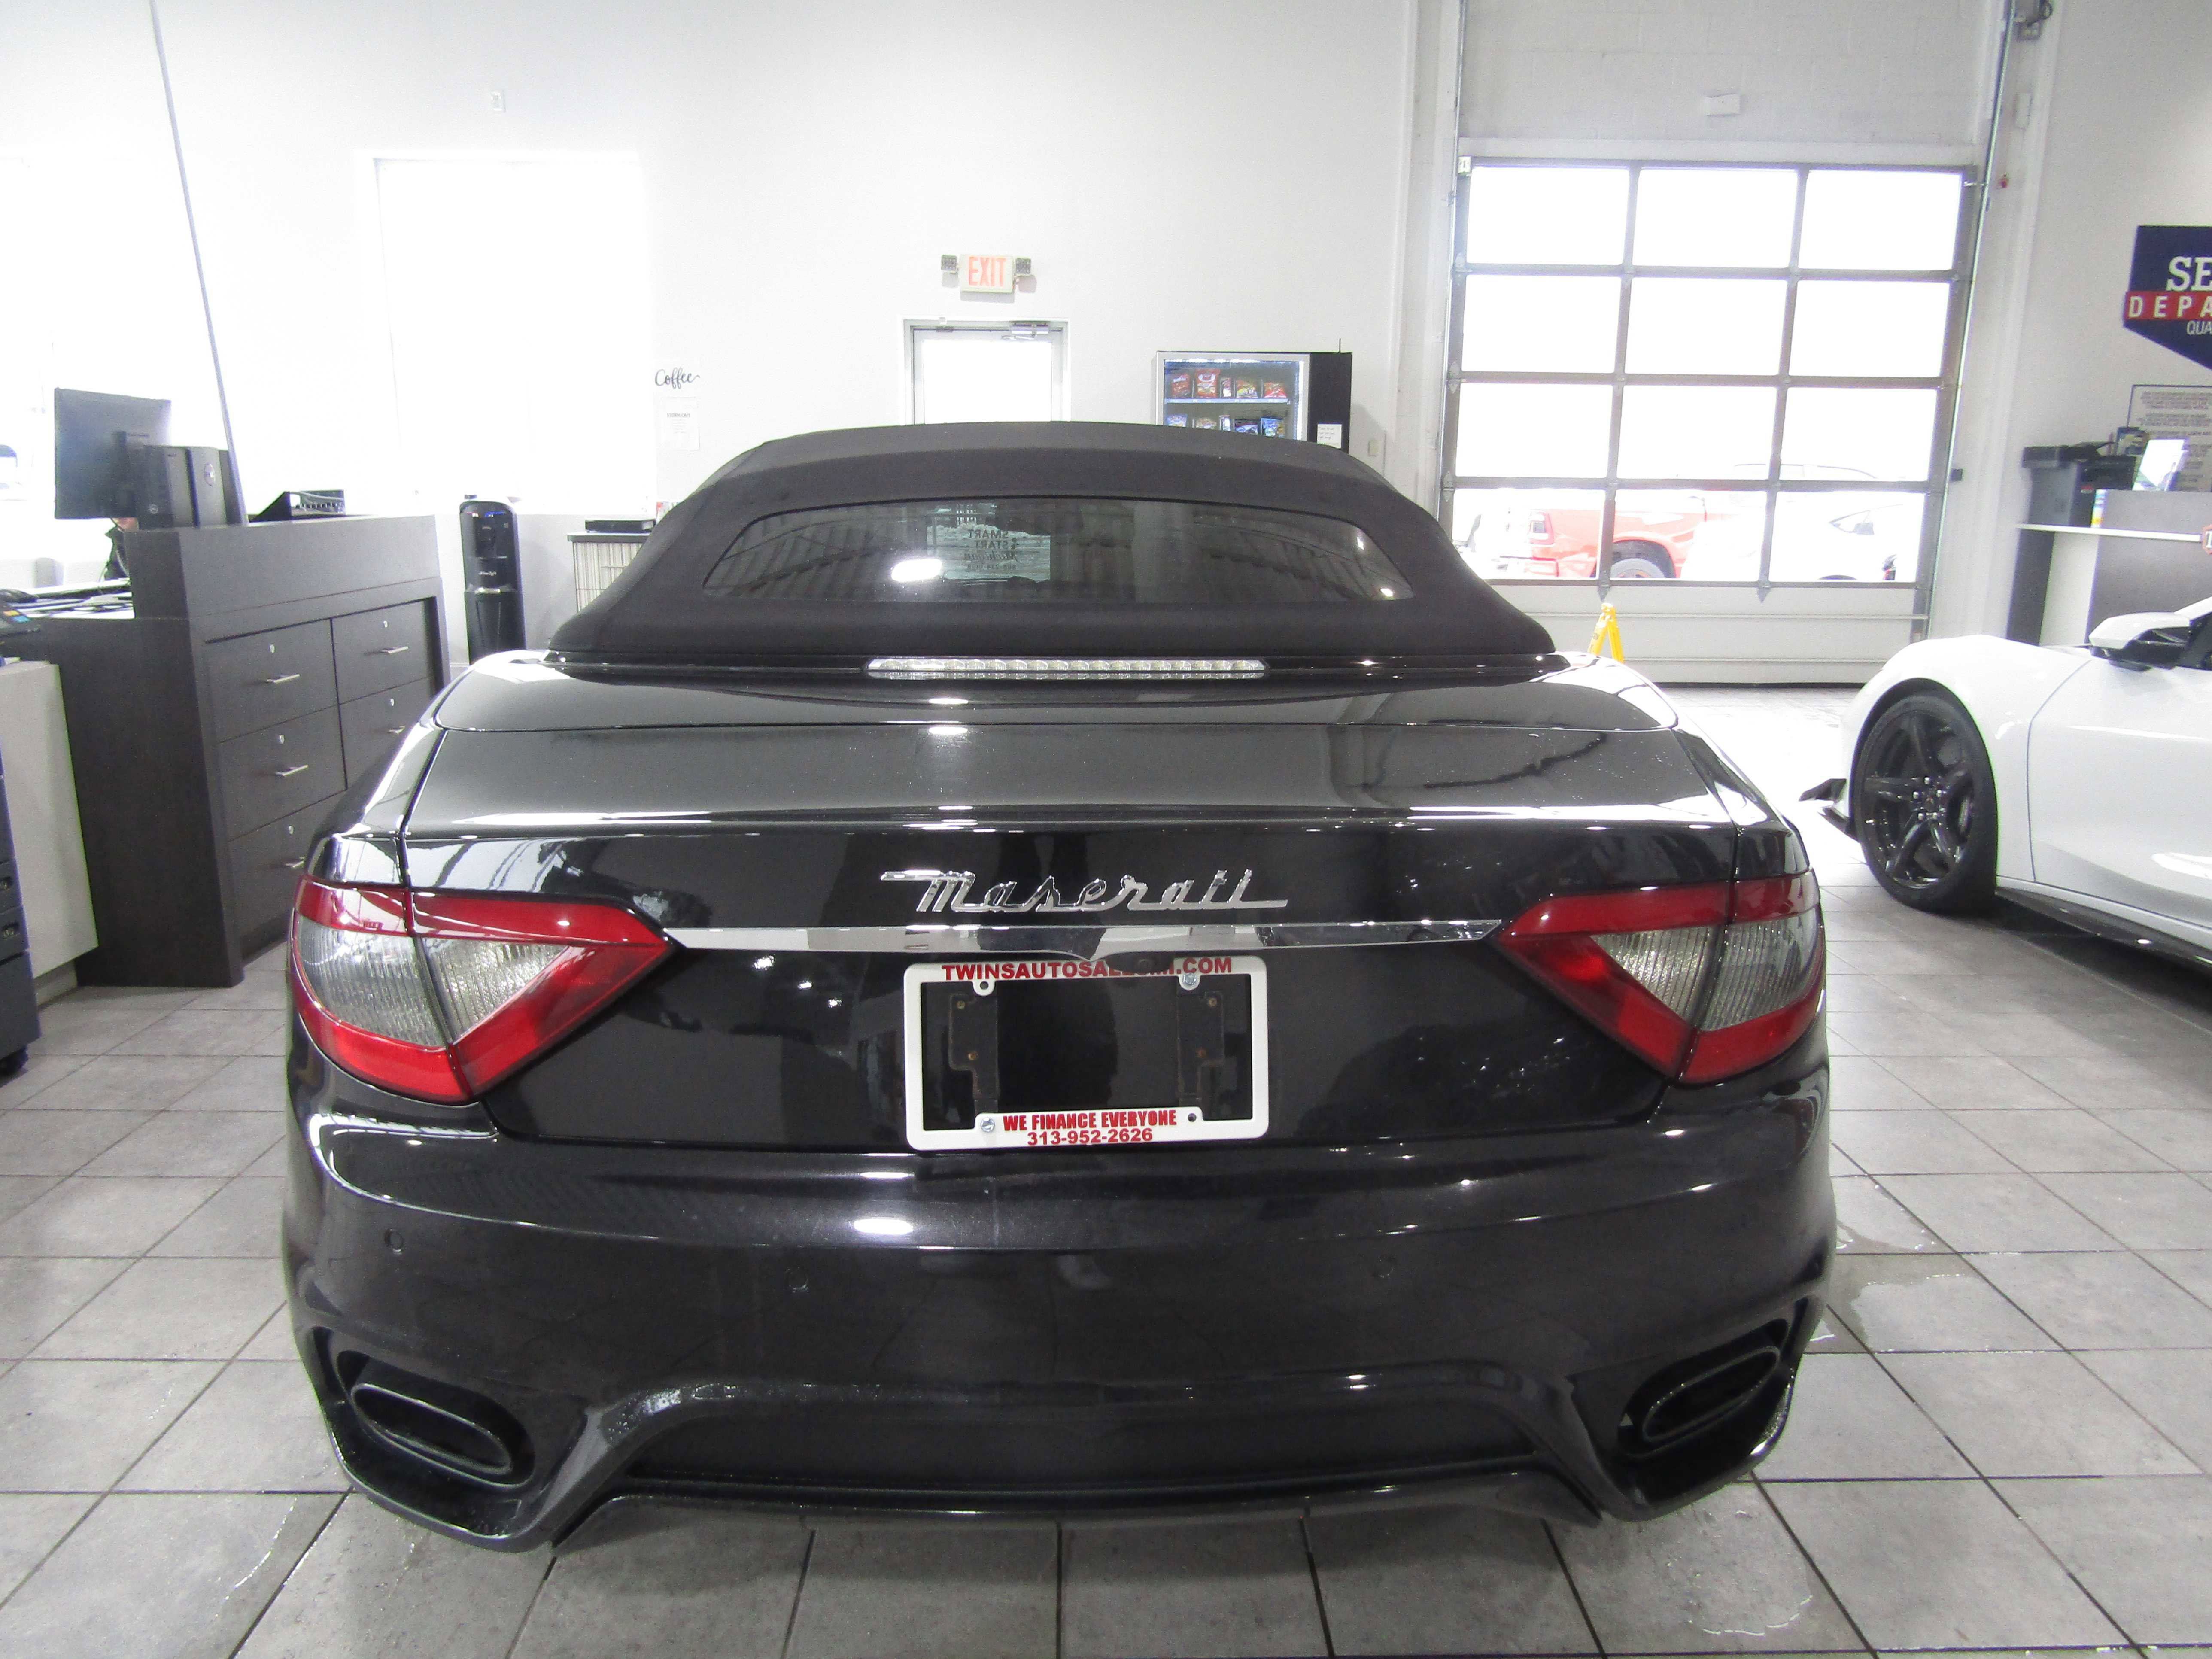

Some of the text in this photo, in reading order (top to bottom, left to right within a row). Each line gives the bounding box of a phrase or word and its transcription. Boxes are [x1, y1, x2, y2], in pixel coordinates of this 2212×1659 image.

[968, 256, 1007, 286] EXIT
[655, 367, 701, 389] Coffee
[880, 869, 1288, 912] Maserati
[942, 957, 1232, 981] TWINSAUTOSALI.COM
[1003, 1110, 1177, 1131] WE FINANCE EVERYONE
[1027, 1127, 1153, 1146] 313-952-2626
